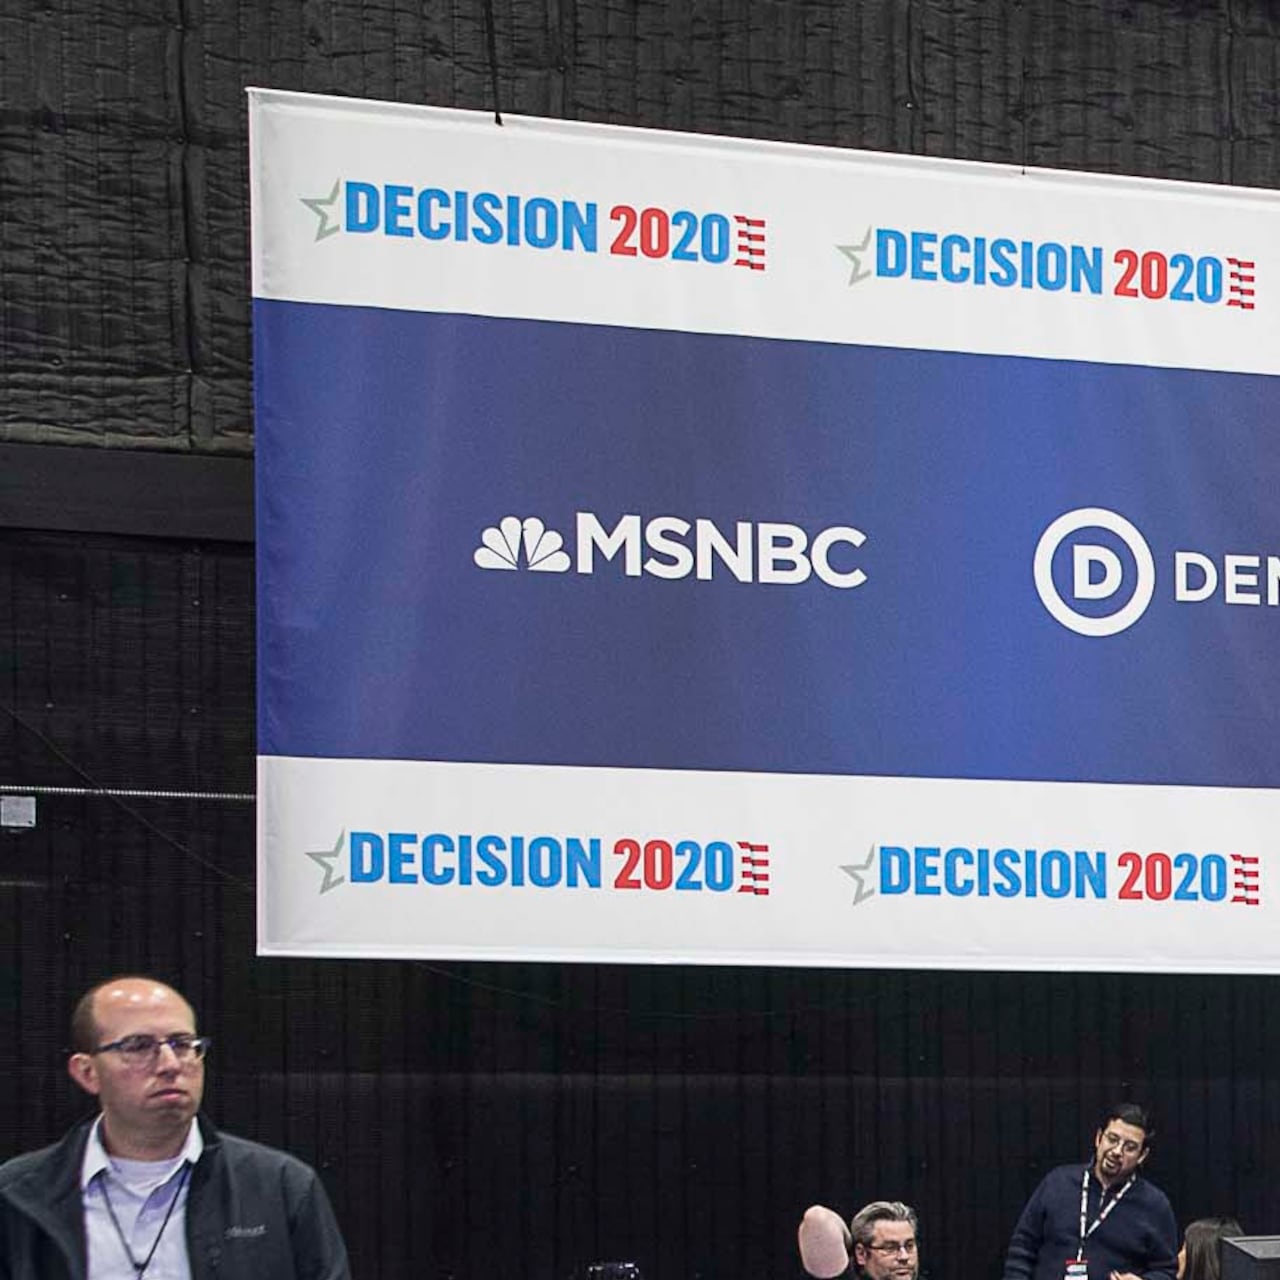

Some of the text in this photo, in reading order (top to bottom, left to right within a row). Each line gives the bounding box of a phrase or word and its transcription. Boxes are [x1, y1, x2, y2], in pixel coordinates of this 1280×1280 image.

[345, 181, 730, 265] DECISION 2020
[876, 229, 1223, 305] DECISION 2020
[577, 513, 867, 588] MSNBC
[349, 832, 734, 892] DECISION 2020
[880, 846, 1228, 903] DECISION 2020
